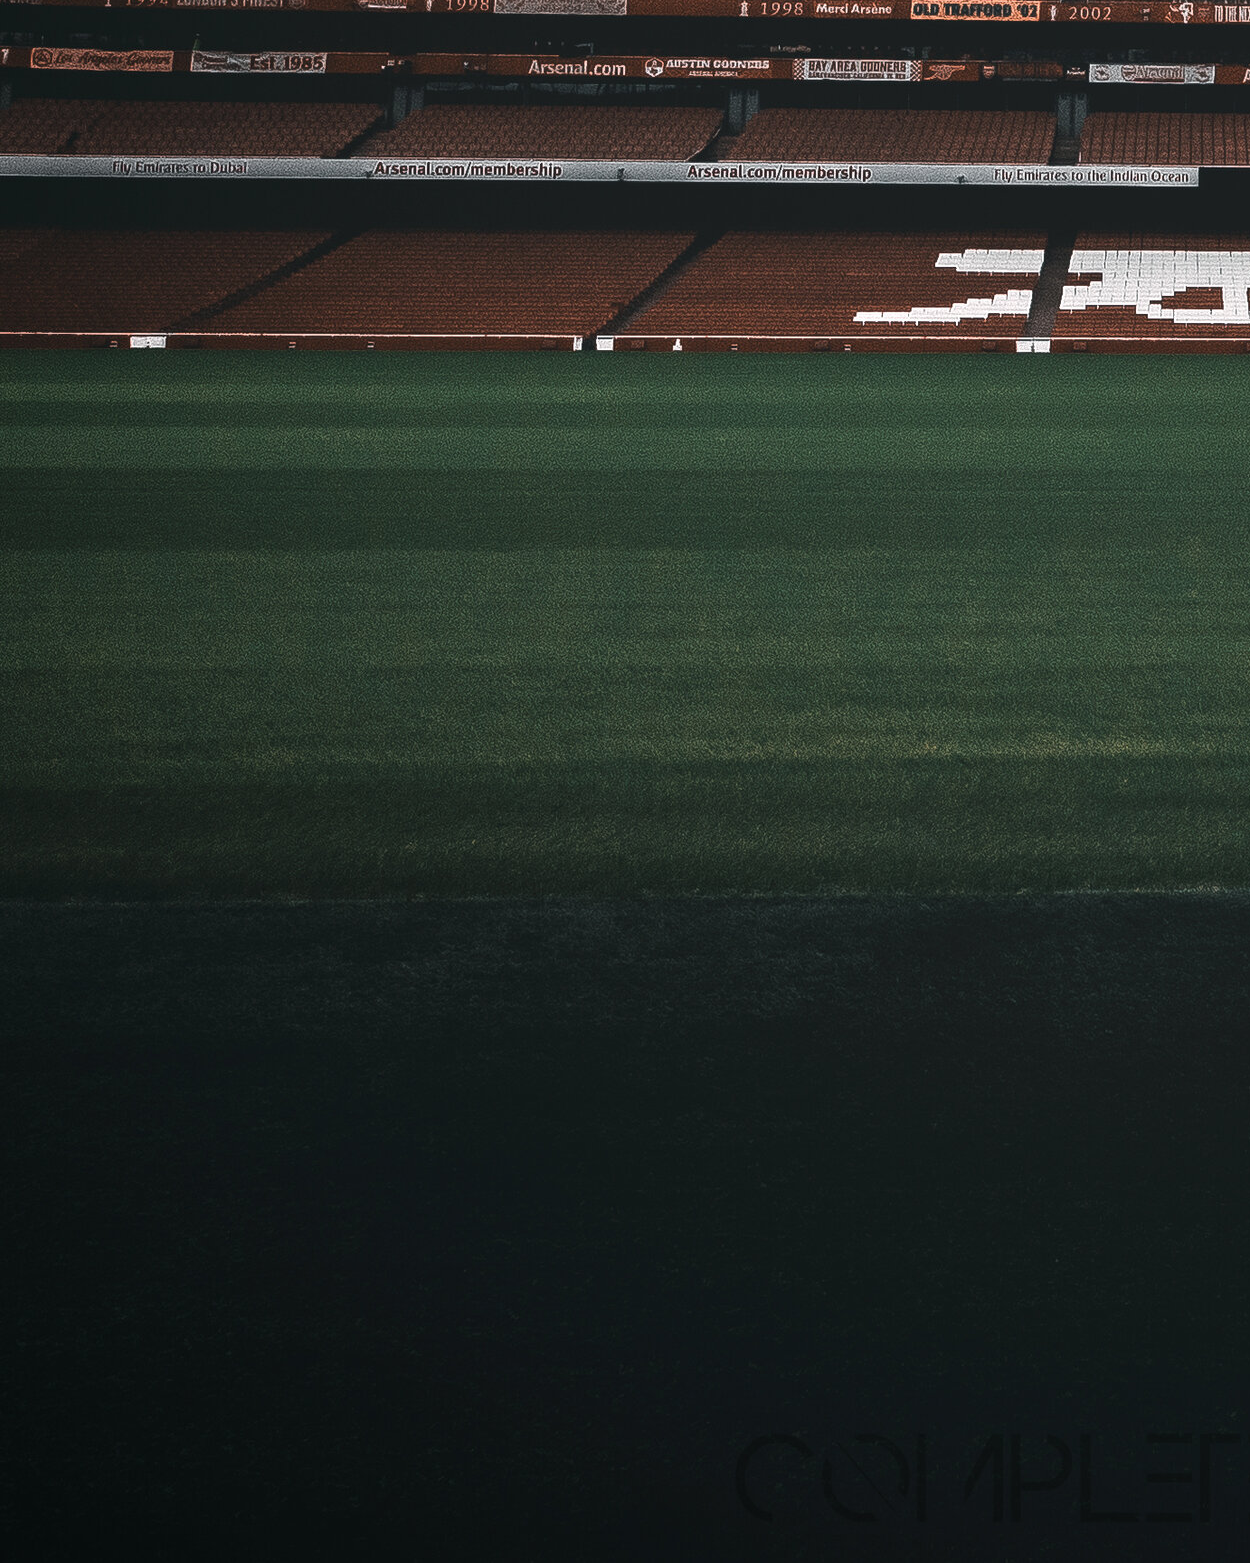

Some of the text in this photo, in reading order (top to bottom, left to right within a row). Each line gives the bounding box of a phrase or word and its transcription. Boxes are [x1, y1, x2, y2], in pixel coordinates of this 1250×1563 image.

[760, 2, 804, 16] 1998
[816, 2, 892, 14] Merci Arsène
[913, 3, 940, 16] OLD
[944, 4, 1012, 17] TRAFFORD
[1069, 6, 1112, 20] 2002
[1214, 5, 1224, 22] TO
[283, 56, 323, 70] 1985
[528, 59, 626, 76] Arsenal.com
[666, 59, 770, 69] AUSTIN GOONERS
[809, 60, 906, 72] BAY AREA GOONERS
[113, 161, 247, 175] Fly Emirates to Dubai
[374, 161, 562, 179] Arsenal.com/membership
[687, 165, 872, 182] Arsenal.com/membership
[994, 169, 1189, 183] Fly Emirates to the Indian Ocean
